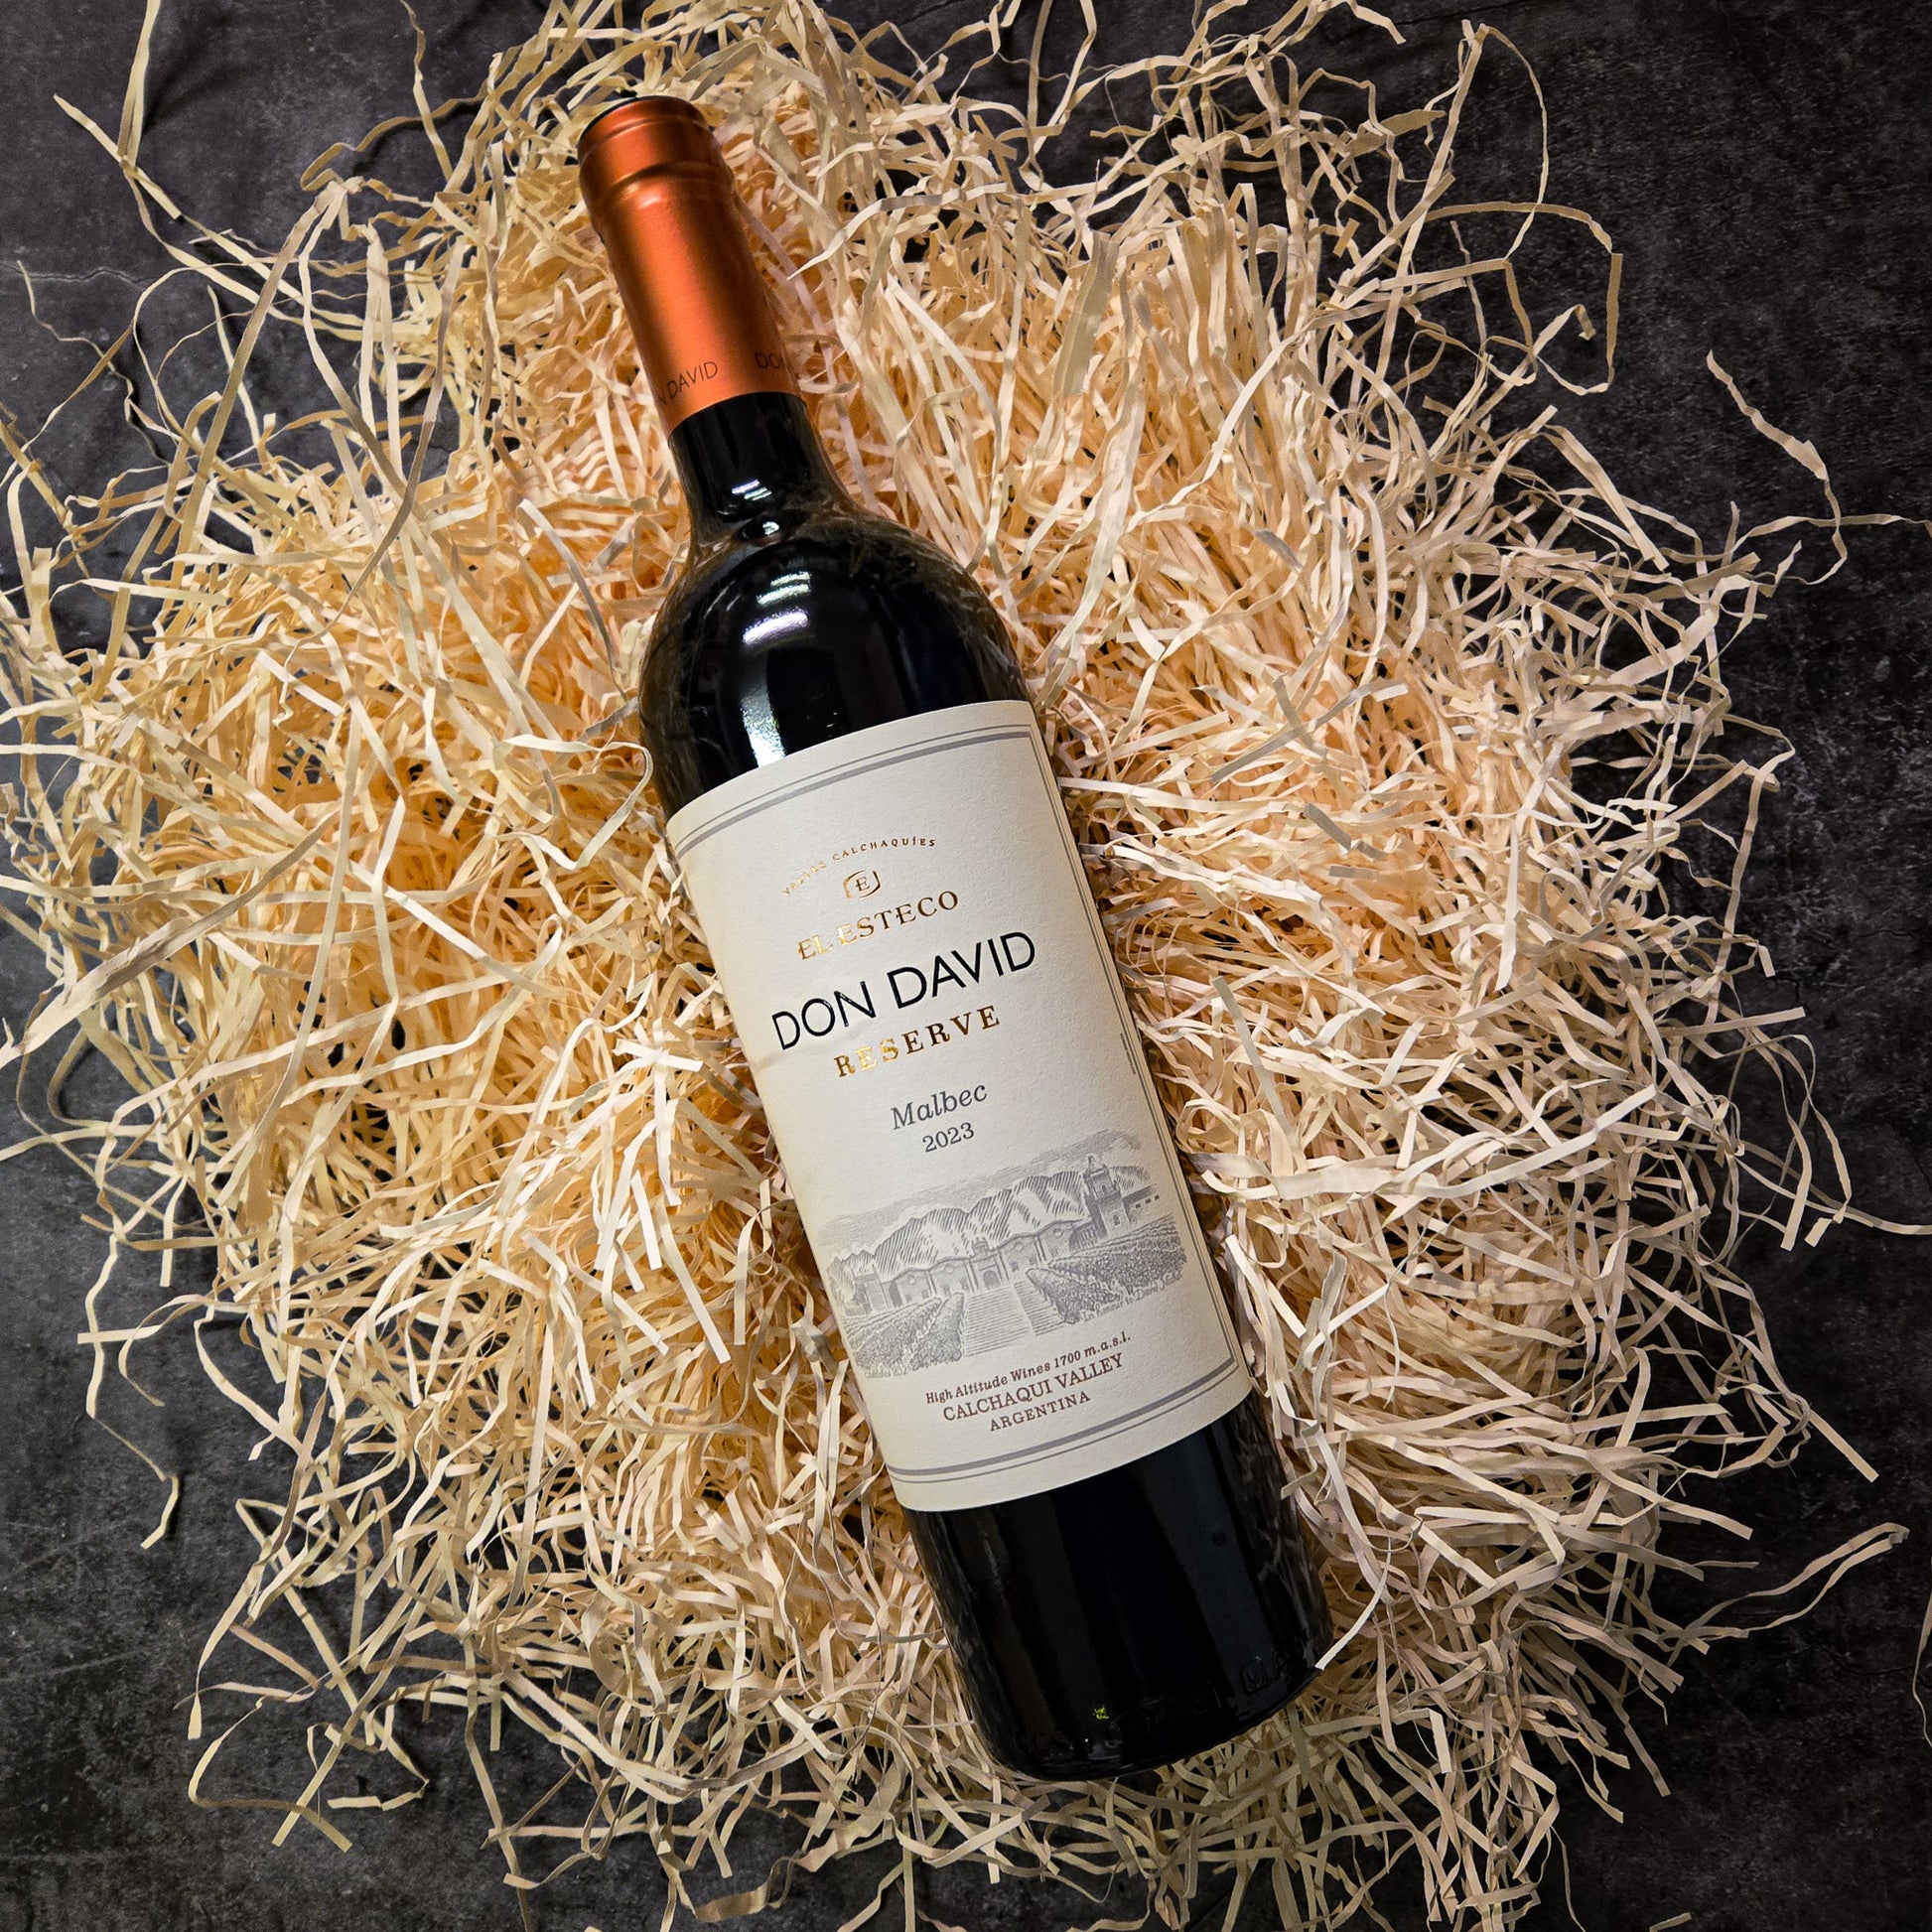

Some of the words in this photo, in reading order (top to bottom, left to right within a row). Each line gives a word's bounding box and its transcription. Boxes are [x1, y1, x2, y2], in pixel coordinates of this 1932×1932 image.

[666, 361, 718, 399] DAVID
[755, 351, 783, 369] DO
[797, 934, 833, 960] EL
[836, 891, 959, 945] ESTECO
[772, 981, 877, 1050] DON
[887, 931, 1035, 1010] DAVID
[833, 1005, 1001, 1078] RESERVE
[891, 1084, 988, 1130] Malbec
[922, 1122, 975, 1153] 2023
[925, 1388, 953, 1404] High
[955, 1374, 1008, 1397] Altitude
[1010, 1363, 1051, 1382] Wines
[1054, 1350, 1081, 1369] 1700
[1084, 1330, 1131, 1358] m.a.s.l.
[943, 1378, 1053, 1422] CALCHAQUI
[1054, 1352, 1123, 1388] VALLEY
[990, 1390, 1091, 1432] ARGENTINA
